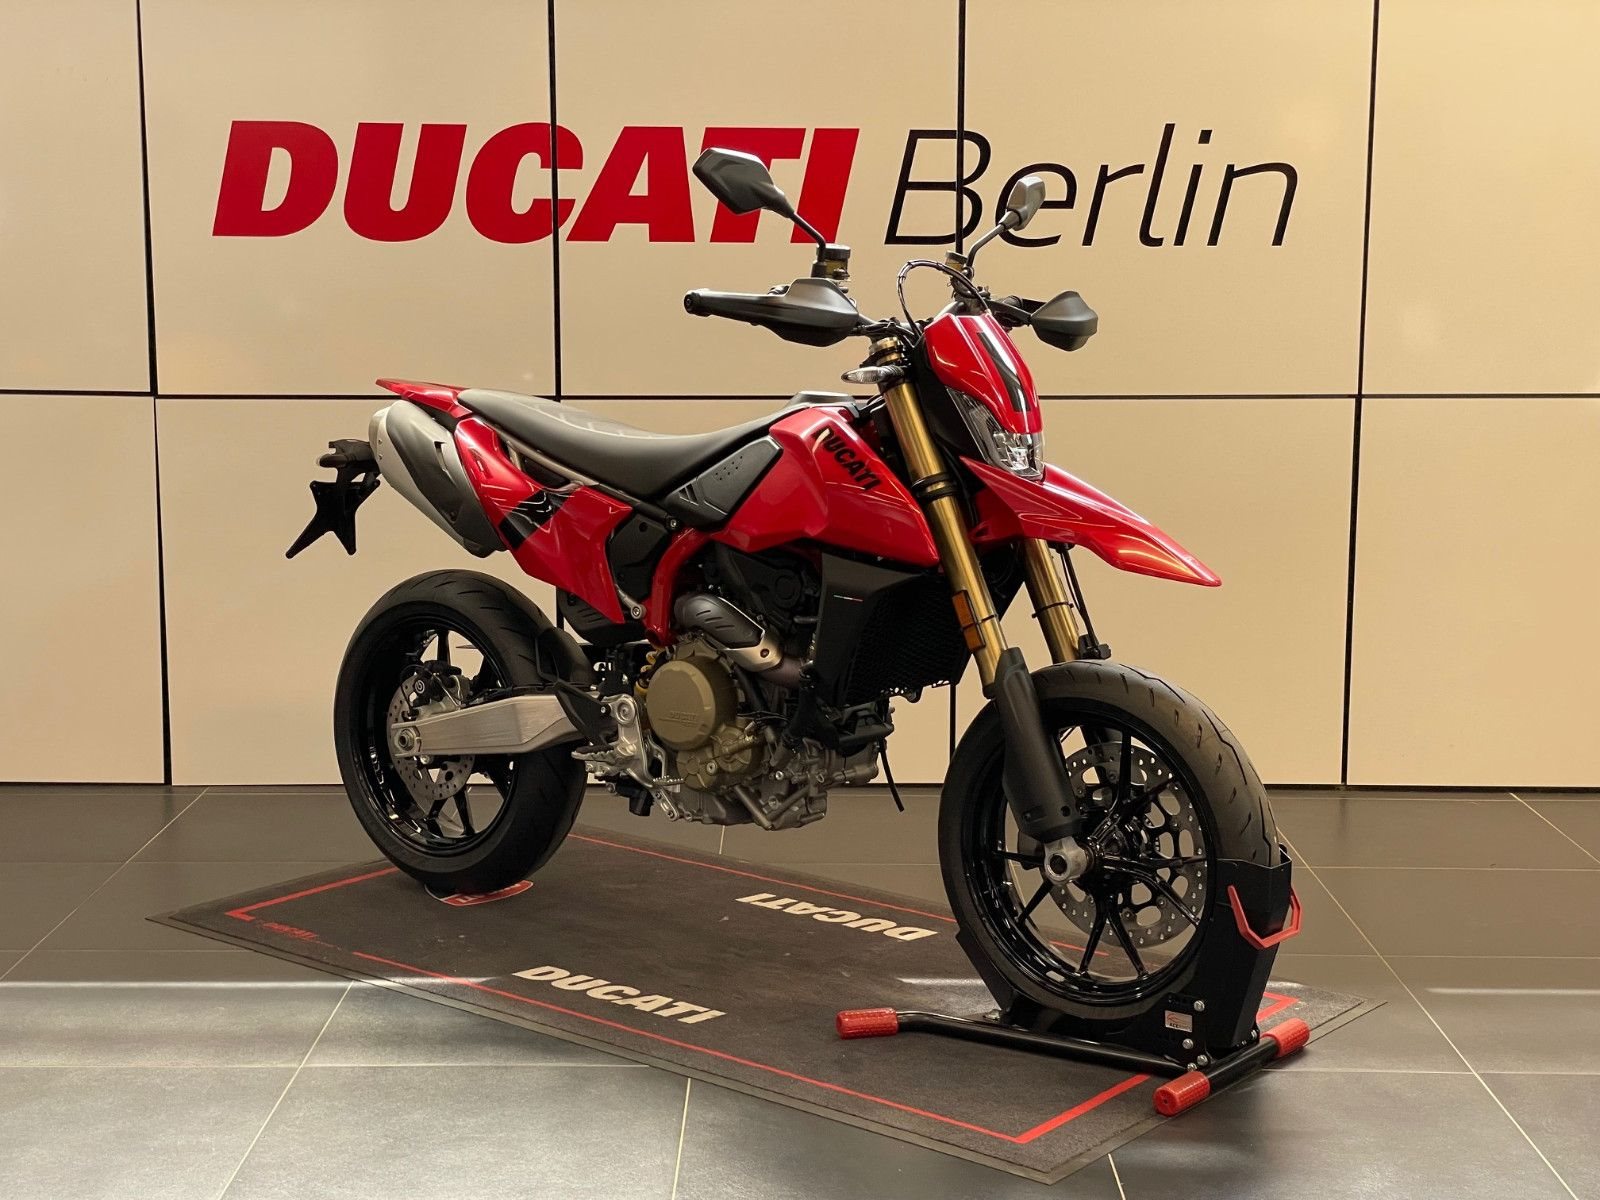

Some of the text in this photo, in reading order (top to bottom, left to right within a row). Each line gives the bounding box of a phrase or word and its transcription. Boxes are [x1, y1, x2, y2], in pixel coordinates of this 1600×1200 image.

[213, 120, 1298, 247] DUCATI Berlin
[811, 426, 882, 491] DUCATI
[735, 892, 938, 941] DUCATI
[511, 965, 727, 1024] DUCATI
